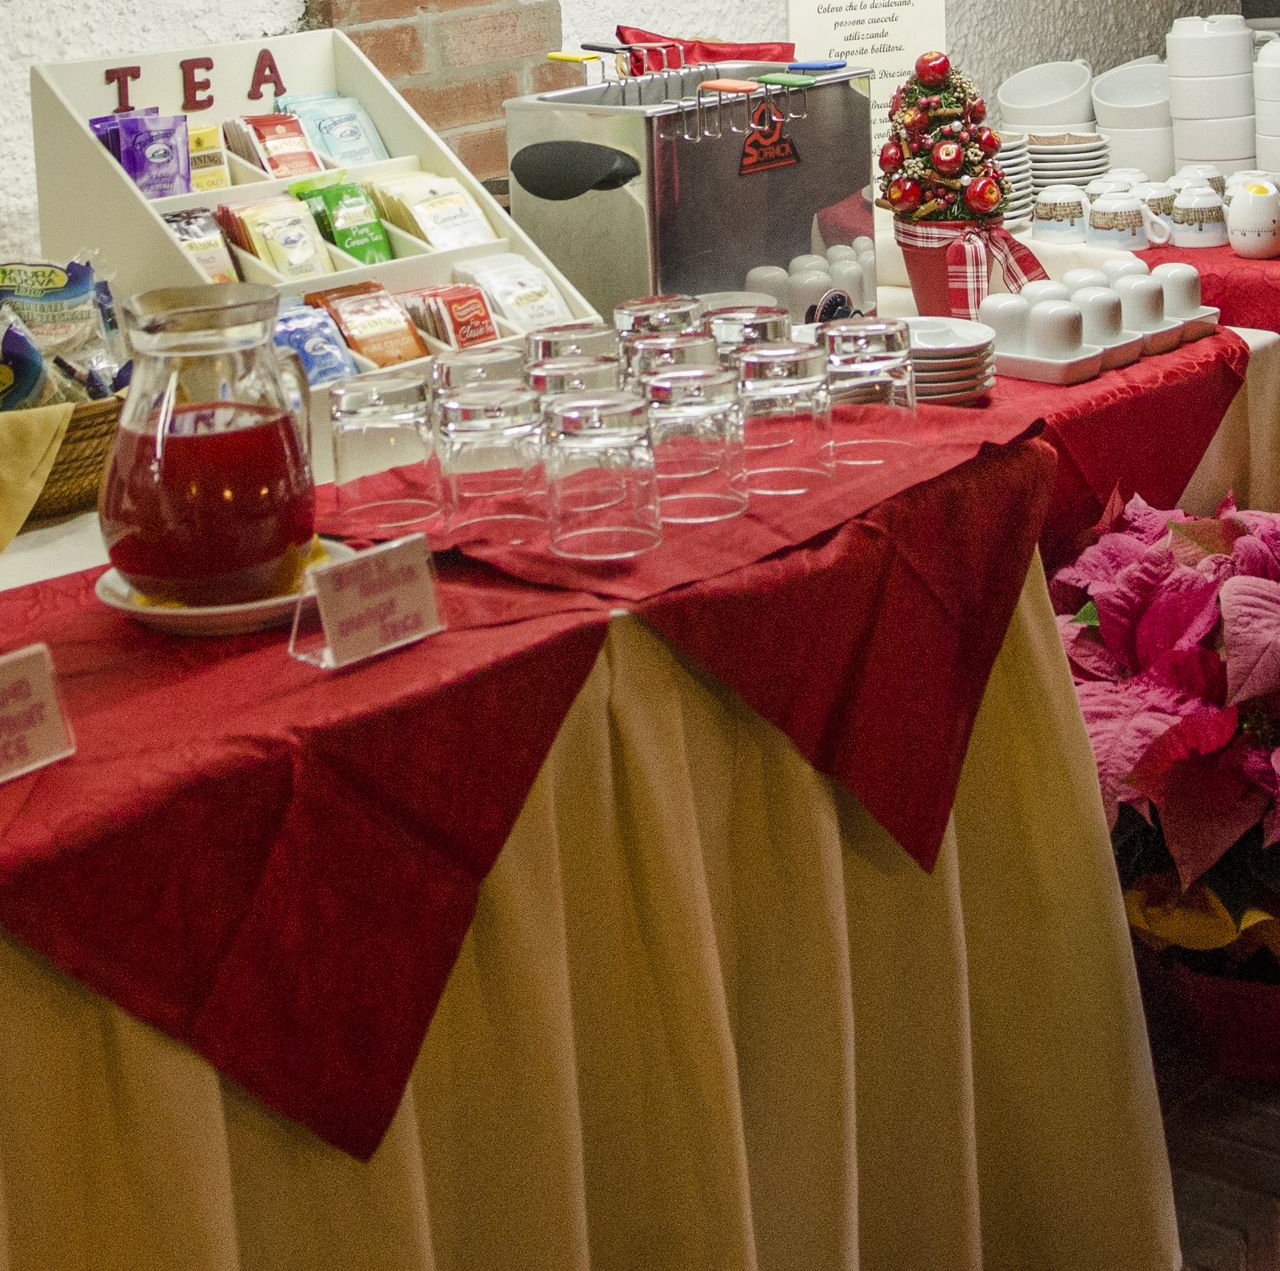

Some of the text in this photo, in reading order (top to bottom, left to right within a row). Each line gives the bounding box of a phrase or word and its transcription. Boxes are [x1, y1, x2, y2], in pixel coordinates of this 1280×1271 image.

[817, 3, 843, 14] Coloro
[845, 1, 858, 12] che
[860, 0, 867, 10] lo
[834, 12, 899, 31] possono cuocerle
[843, 28, 889, 42] utilizzando
[828, 44, 905, 60] l'apposito bollitore.
[105, 48, 286, 114] TEA
[191, 154, 223, 166] ININGS
[345, 236, 369, 248] Green
